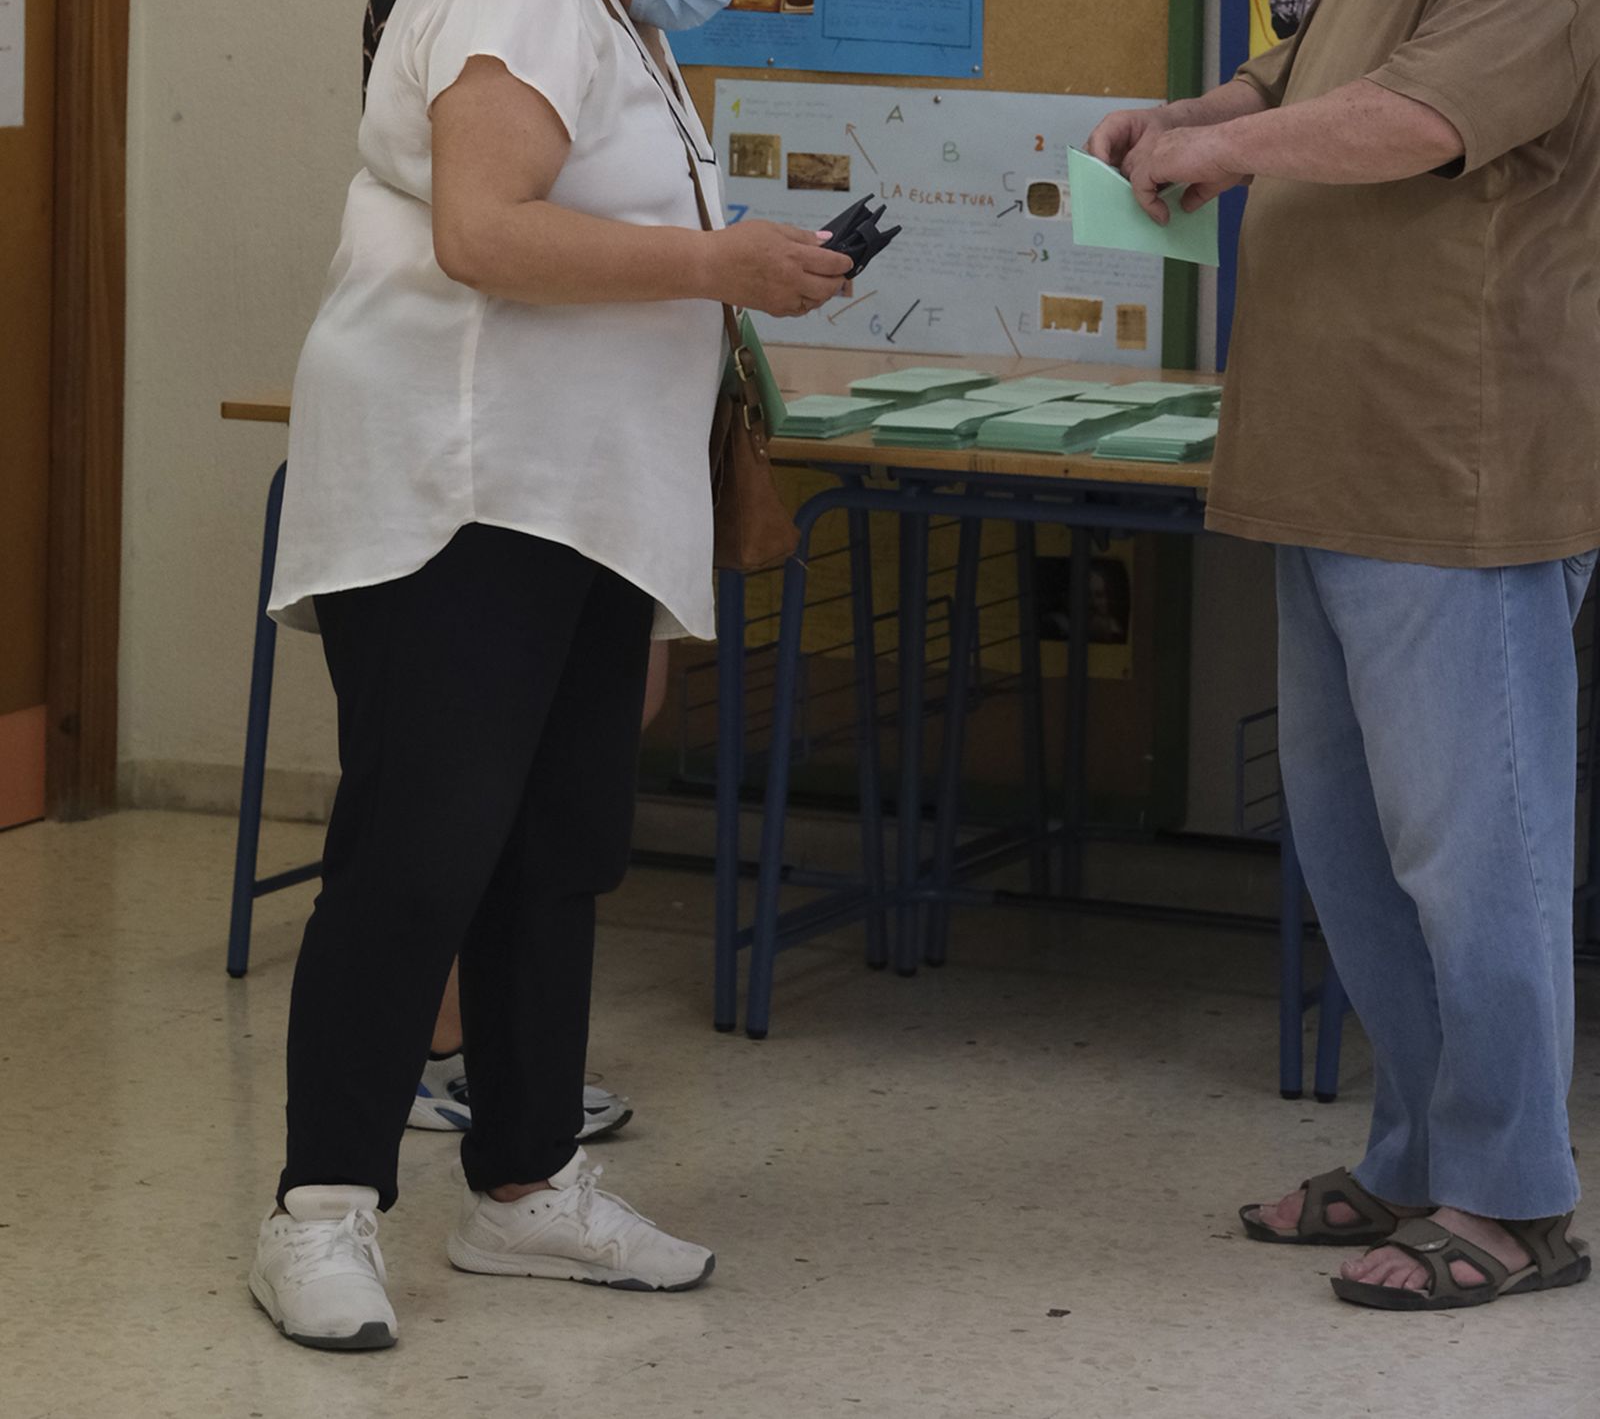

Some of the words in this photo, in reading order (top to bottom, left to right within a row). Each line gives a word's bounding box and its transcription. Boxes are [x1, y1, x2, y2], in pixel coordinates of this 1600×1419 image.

[886, 104, 904, 124] A
[942, 140, 960, 163] B
[1034, 134, 1045, 152] 2
[880, 181, 903, 200] LA
